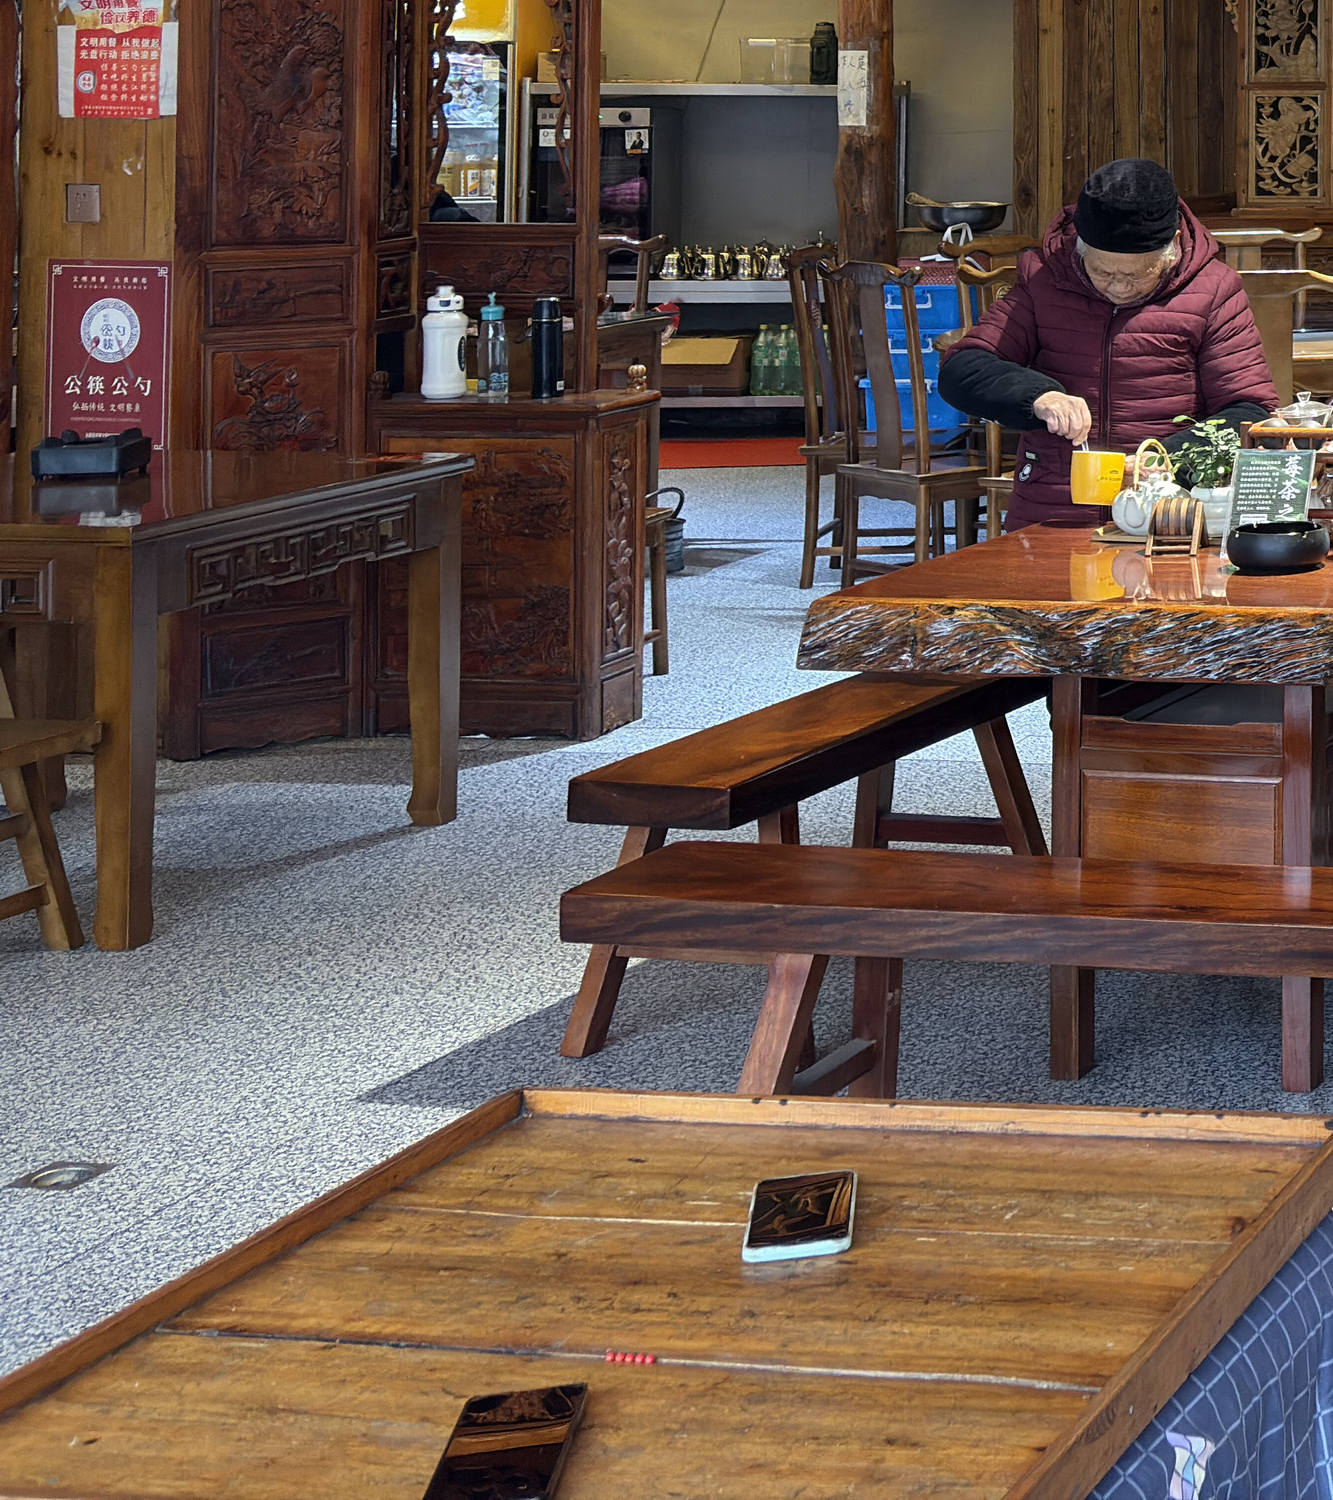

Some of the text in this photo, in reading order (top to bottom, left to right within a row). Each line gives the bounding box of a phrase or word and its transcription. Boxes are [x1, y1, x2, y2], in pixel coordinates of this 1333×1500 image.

[100, 8, 159, 25] 俭以养德
[80, 37, 117, 47] 文明用餐
[64, 375, 151, 396] 公筷公勺
[72, 402, 140, 413] 弘扬传统 文明餐桌
